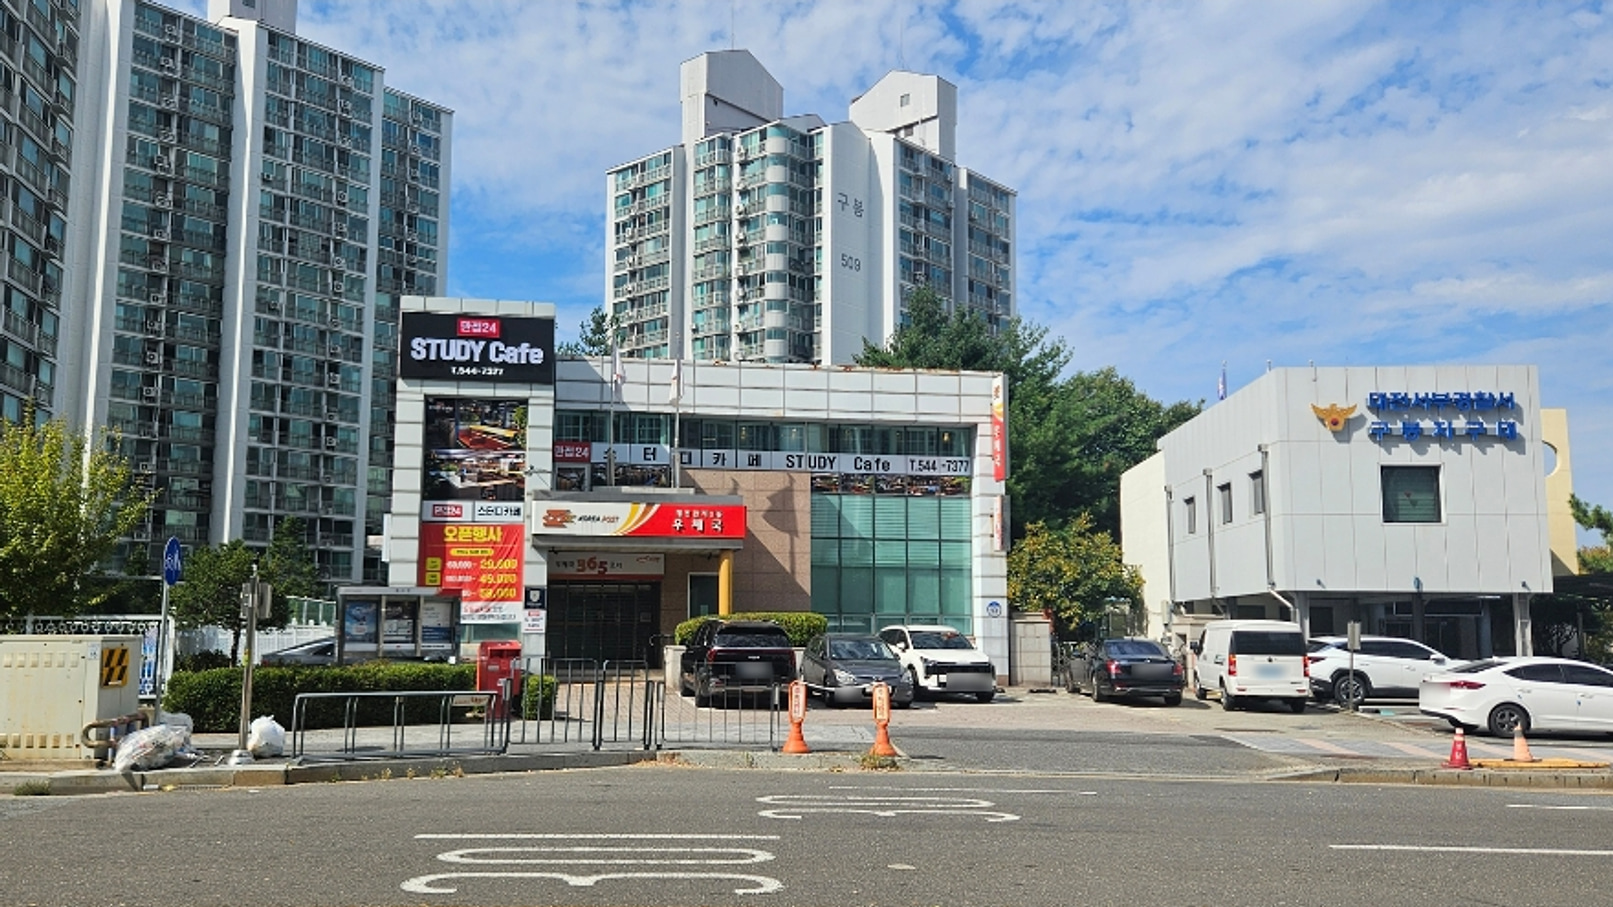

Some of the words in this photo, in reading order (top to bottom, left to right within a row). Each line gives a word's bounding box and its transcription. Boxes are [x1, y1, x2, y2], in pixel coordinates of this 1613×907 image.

[837, 192, 864, 218] 구봉
[841, 253, 861, 272] 509
[410, 337, 486, 362] STUDY
[489, 341, 544, 365] Cafe
[1368, 391, 1516, 411] 대전서부경찰서
[1369, 421, 1517, 441] 구봉지구대
[786, 454, 837, 471] STUDY
[854, 456, 891, 471] Cafe
[443, 525, 502, 542] 오픈행사
[672, 518, 723, 532] 우체국
[576, 556, 608, 575] 365
